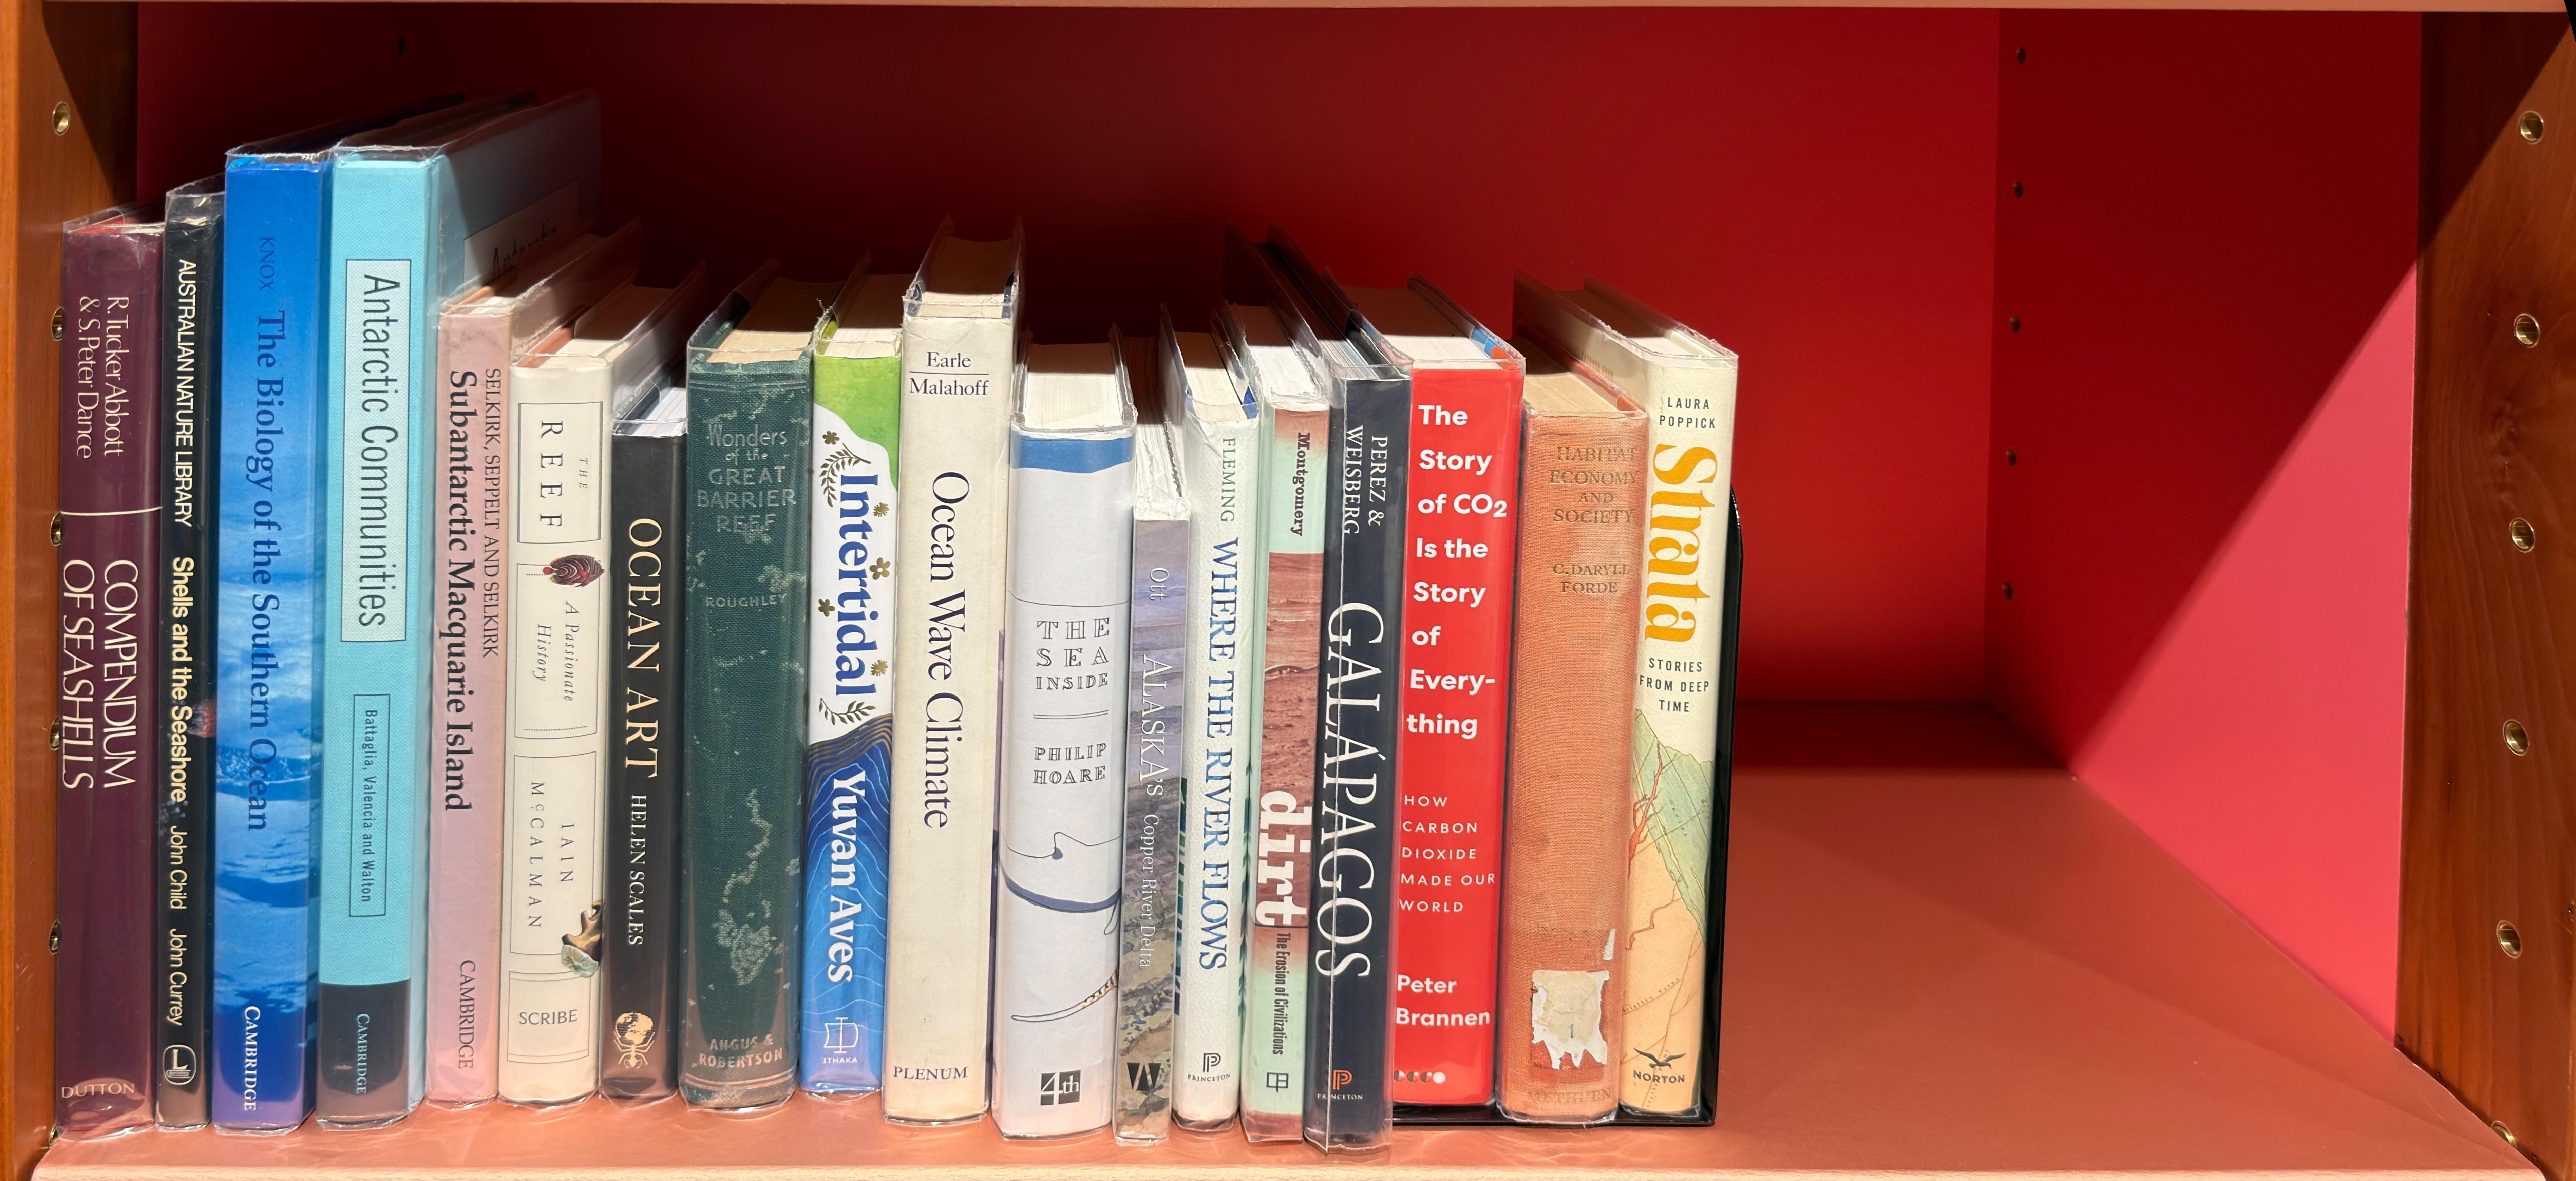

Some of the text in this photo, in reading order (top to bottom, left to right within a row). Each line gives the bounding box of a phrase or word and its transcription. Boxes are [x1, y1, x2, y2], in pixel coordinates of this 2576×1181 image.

[259, 236, 276, 291] KNOX
[79, 296, 101, 312] &
[105, 314, 129, 381] Tucker
[927, 351, 971, 368] Earle
[77, 335, 100, 387] Peter
[174, 259, 196, 527] AUSTRALIAN NATURE LIBRARY
[910, 378, 989, 395] Malahoff
[1418, 405, 1468, 425] The
[1667, 397, 1709, 409] LAURA
[77, 392, 99, 459] Dance
[103, 383, 129, 457] Abbott
[1660, 415, 1716, 428] POPPICK
[708, 424, 788, 447] Wonders
[359, 274, 400, 626] Antarctic Communities
[725, 448, 768, 465] of the
[1419, 449, 1493, 475] Story
[1556, 446, 1637, 461] HABITAT
[540, 420, 564, 527] REEF
[579, 458, 588, 489] THE
[708, 466, 786, 485] GREAT
[1220, 437, 1236, 522] FLEMING
[1290, 432, 1310, 536] Montgomery
[1344, 425, 1363, 534] WEISBERG
[1368, 436, 1388, 526] PEREZ &
[1549, 470, 1640, 485] ECONOMY
[698, 489, 797, 508] BARRIER
[1418, 493, 1447, 514] of
[1578, 493, 1614, 504] AND
[482, 368, 501, 658] SELKIRK, SEPPELT AND SELKIRK
[717, 513, 776, 532] REEF
[1553, 509, 1635, 523] SOCIETY
[1416, 537, 1488, 558] Is the
[1645, 444, 1718, 642] Strata
[246, 310, 286, 831] The Biology of the Southern Ocean
[1150, 567, 1169, 600] Ott
[439, 371, 477, 810] Subantarctic Macquarie Island
[835, 474, 879, 696] Intertidal
[1413, 581, 1486, 608] Story
[1561, 582, 1618, 593] FORDE
[705, 593, 787, 607] ROUGHLEY
[1037, 617, 1110, 640] THE
[1412, 626, 1441, 646] of
[532, 624, 552, 681] History
[564, 600, 580, 701] A Passionate
[625, 518, 662, 778] OCEAN ART
[924, 472, 970, 828] Ocean Wave Climate
[1036, 646, 1109, 667] SEA
[62, 560, 95, 789] OF SEASHELLS
[103, 560, 138, 788] COMPENDIUM
[1648, 658, 1703, 672] STORIES
[170, 556, 194, 802] Shells and the Seashore
[1036, 672, 1108, 690] INSIDE
[1410, 669, 1495, 695] Every-
[1639, 675, 1709, 692] FROM DEEP
[1659, 700, 1689, 712] TIME
[1406, 713, 1478, 739] thing
[1034, 743, 1106, 760] PHILIP
[1199, 537, 1238, 970] WHERE THE RIVER FLOWS
[1033, 765, 1105, 784] HOARE
[1315, 602, 1386, 977] GALÁPAGOS
[1404, 795, 1447, 807] HOW
[361, 709, 378, 902] Battaglia, Valencia and Walton
[1402, 821, 1477, 833] CARBON
[561, 823, 574, 882] IAIN
[1256, 790, 1312, 926] dirt
[1402, 847, 1476, 859] DIOXIDE
[170, 825, 188, 910] John Child
[628, 795, 647, 945] HELEN SCALES
[828, 770, 866, 982] Yuvan Aves
[1401, 873, 1495, 886] MADE OUR
[1140, 814, 1159, 969] Copper River Delta
[1399, 899, 1463, 912] WORLD
[167, 929, 187, 1026] John Currey
[1397, 974, 1457, 993] Peter
[1272, 933, 1291, 1055] The Erosion of Civilizations
[458, 960, 475, 1069] CAMBRIDGE
[519, 1009, 577, 1025] SCRIBE
[1396, 1007, 1490, 1026] Brannen
[356, 1013, 370, 1094] CAMBRIDGE
[710, 1033, 774, 1051] ANGUS &
[244, 1006, 261, 1111] CAMBRIDGE
[699, 1048, 783, 1068] ROBERTSON
[893, 1066, 968, 1080] PLENUM
[1187, 1072, 1230, 1082] PRINCETON
[1633, 1069, 1685, 1084] NORTON
[61, 1082, 134, 1099] DUTTON
[1040, 1070, 1081, 1105] 4th
